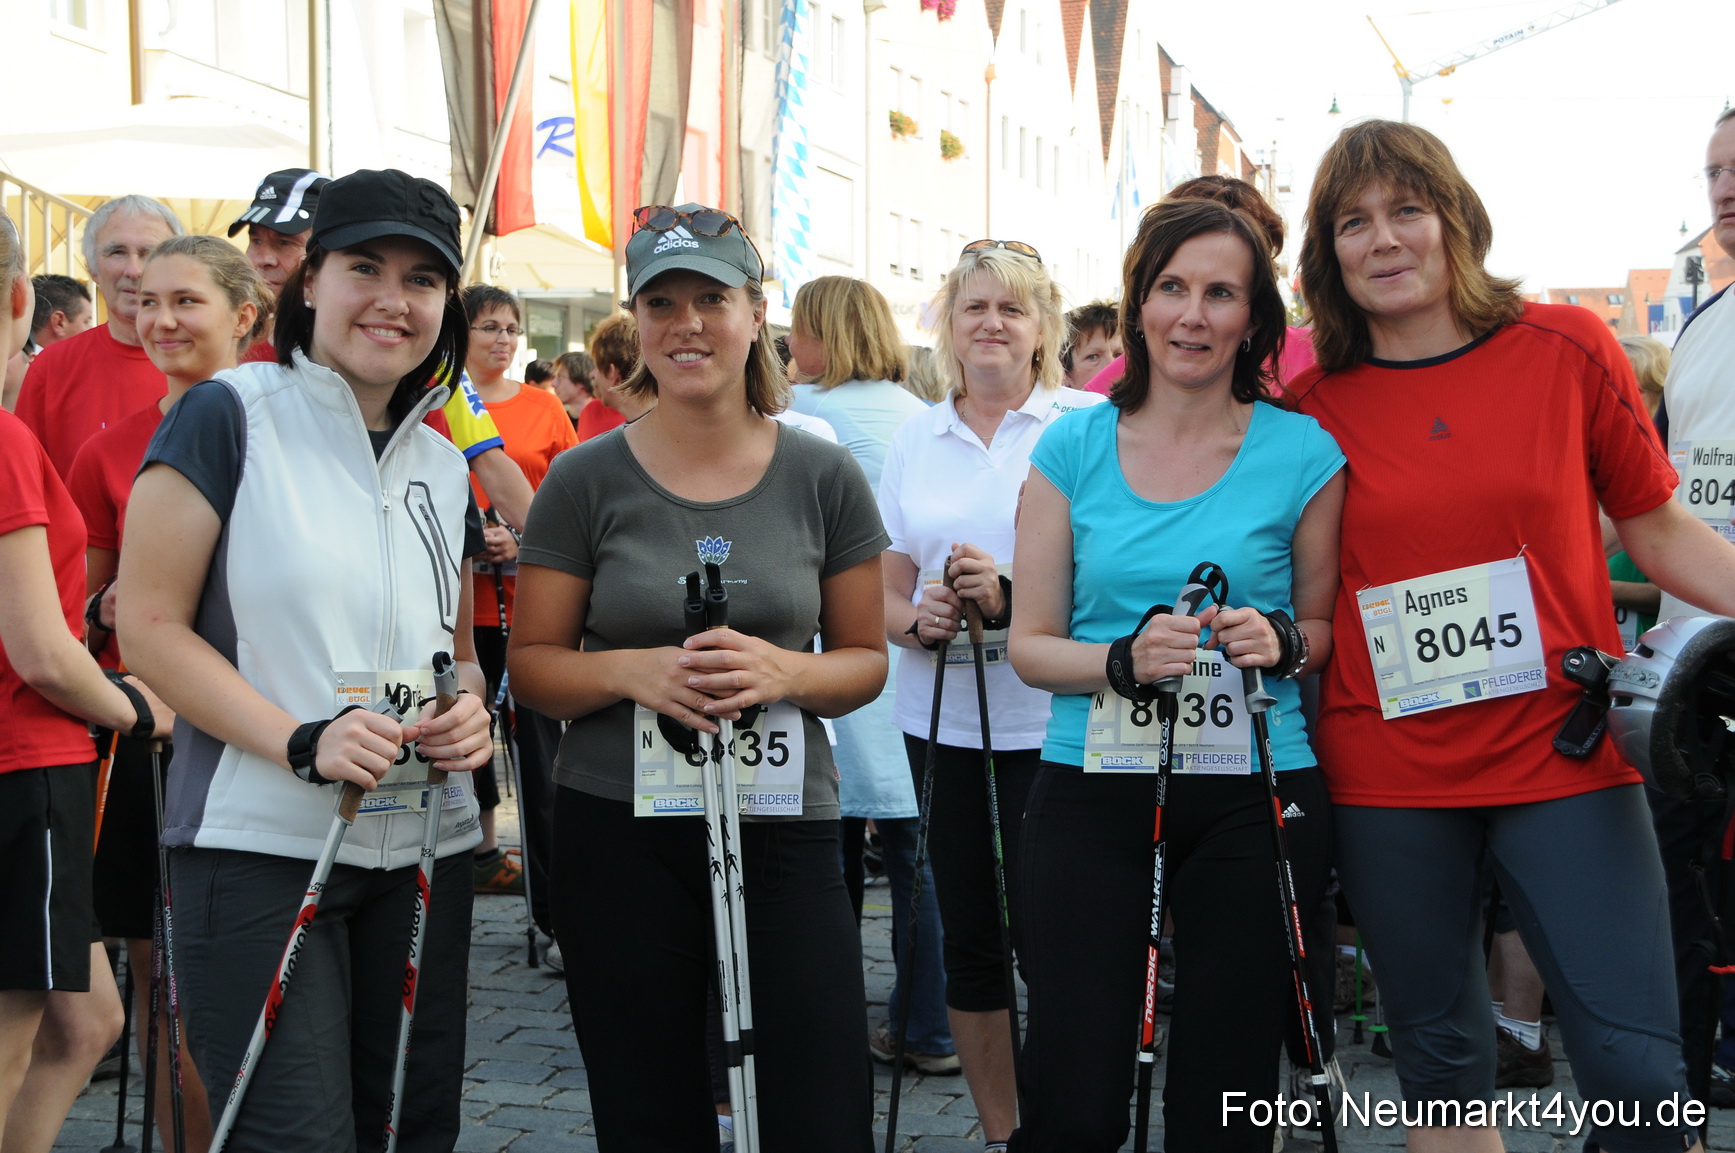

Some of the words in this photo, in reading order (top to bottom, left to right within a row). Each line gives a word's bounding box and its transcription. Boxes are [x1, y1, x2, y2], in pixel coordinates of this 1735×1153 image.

[653, 238, 700, 255] adidas
[1405, 587, 1468, 616] Agnes
[1374, 635, 1386, 654] N
[1414, 611, 1523, 664] 8045
[1481, 669, 1543, 690] PFLEIDERER
[1095, 694, 1105, 710] N
[1400, 691, 1440, 709] BOCK
[642, 731, 653, 749] N
[1101, 756, 1143, 766] BOCK
[1185, 753, 1248, 765] PFLEIDERER
[654, 798, 699, 808] BOCK
[741, 793, 800, 806] PFLEIDERER
[1281, 811, 1305, 819] adidas
[1145, 946, 1157, 1024] NORDIC
